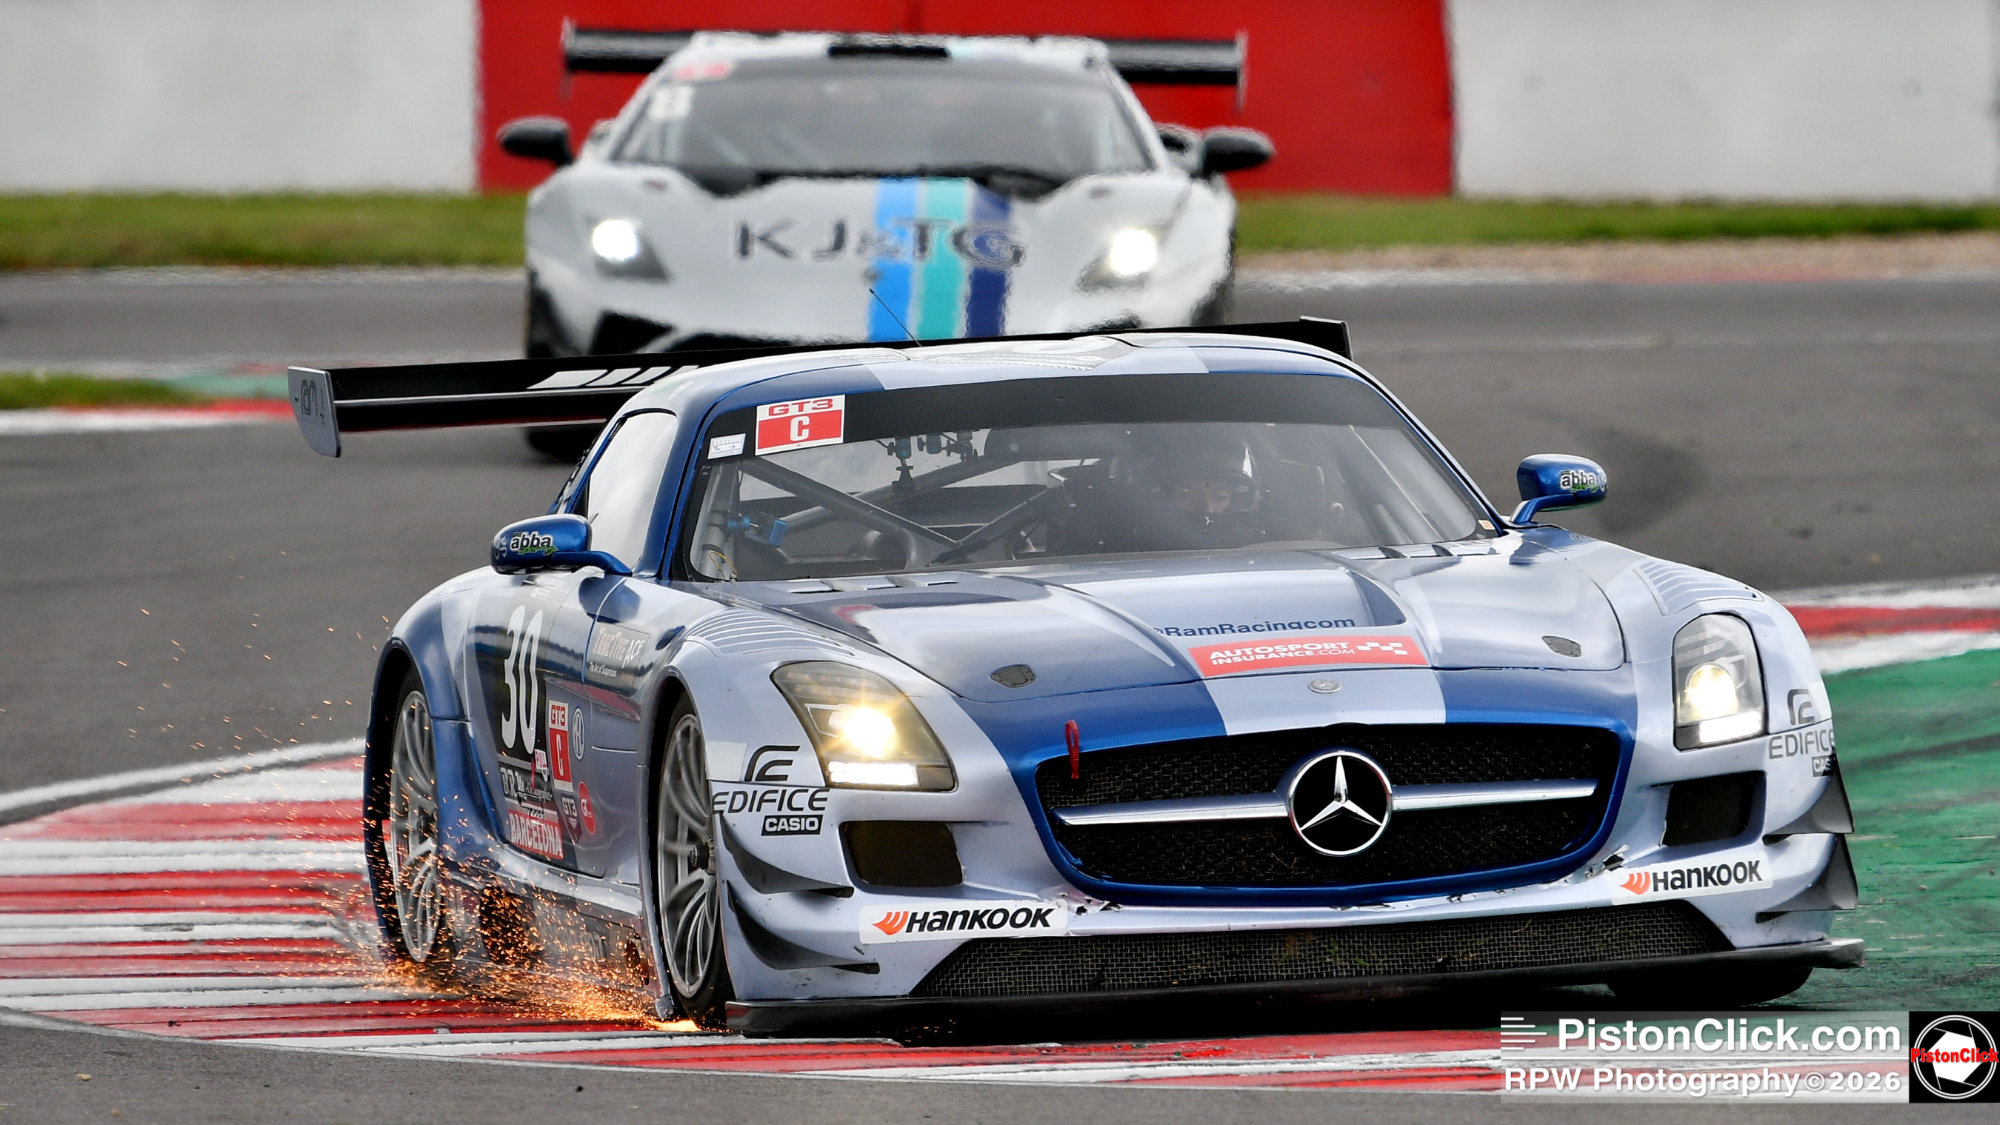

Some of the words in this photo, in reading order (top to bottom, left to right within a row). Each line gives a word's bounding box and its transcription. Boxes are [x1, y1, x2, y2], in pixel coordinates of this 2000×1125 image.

[768, 398, 833, 416] GT3
[790, 415, 810, 442] C
[1561, 470, 1597, 488] abba
[511, 532, 552, 550] abba
[1209, 641, 1349, 660] AUTOSPORT
[1211, 649, 1356, 665] INSURANCE.COM
[501, 605, 543, 754] 30
[551, 704, 566, 727] GT3
[556, 734, 564, 777] C
[562, 797, 578, 817] GT3
[712, 788, 831, 815] EDIFICE
[508, 812, 563, 858] BARCELONA
[764, 817, 819, 833] CASIO
